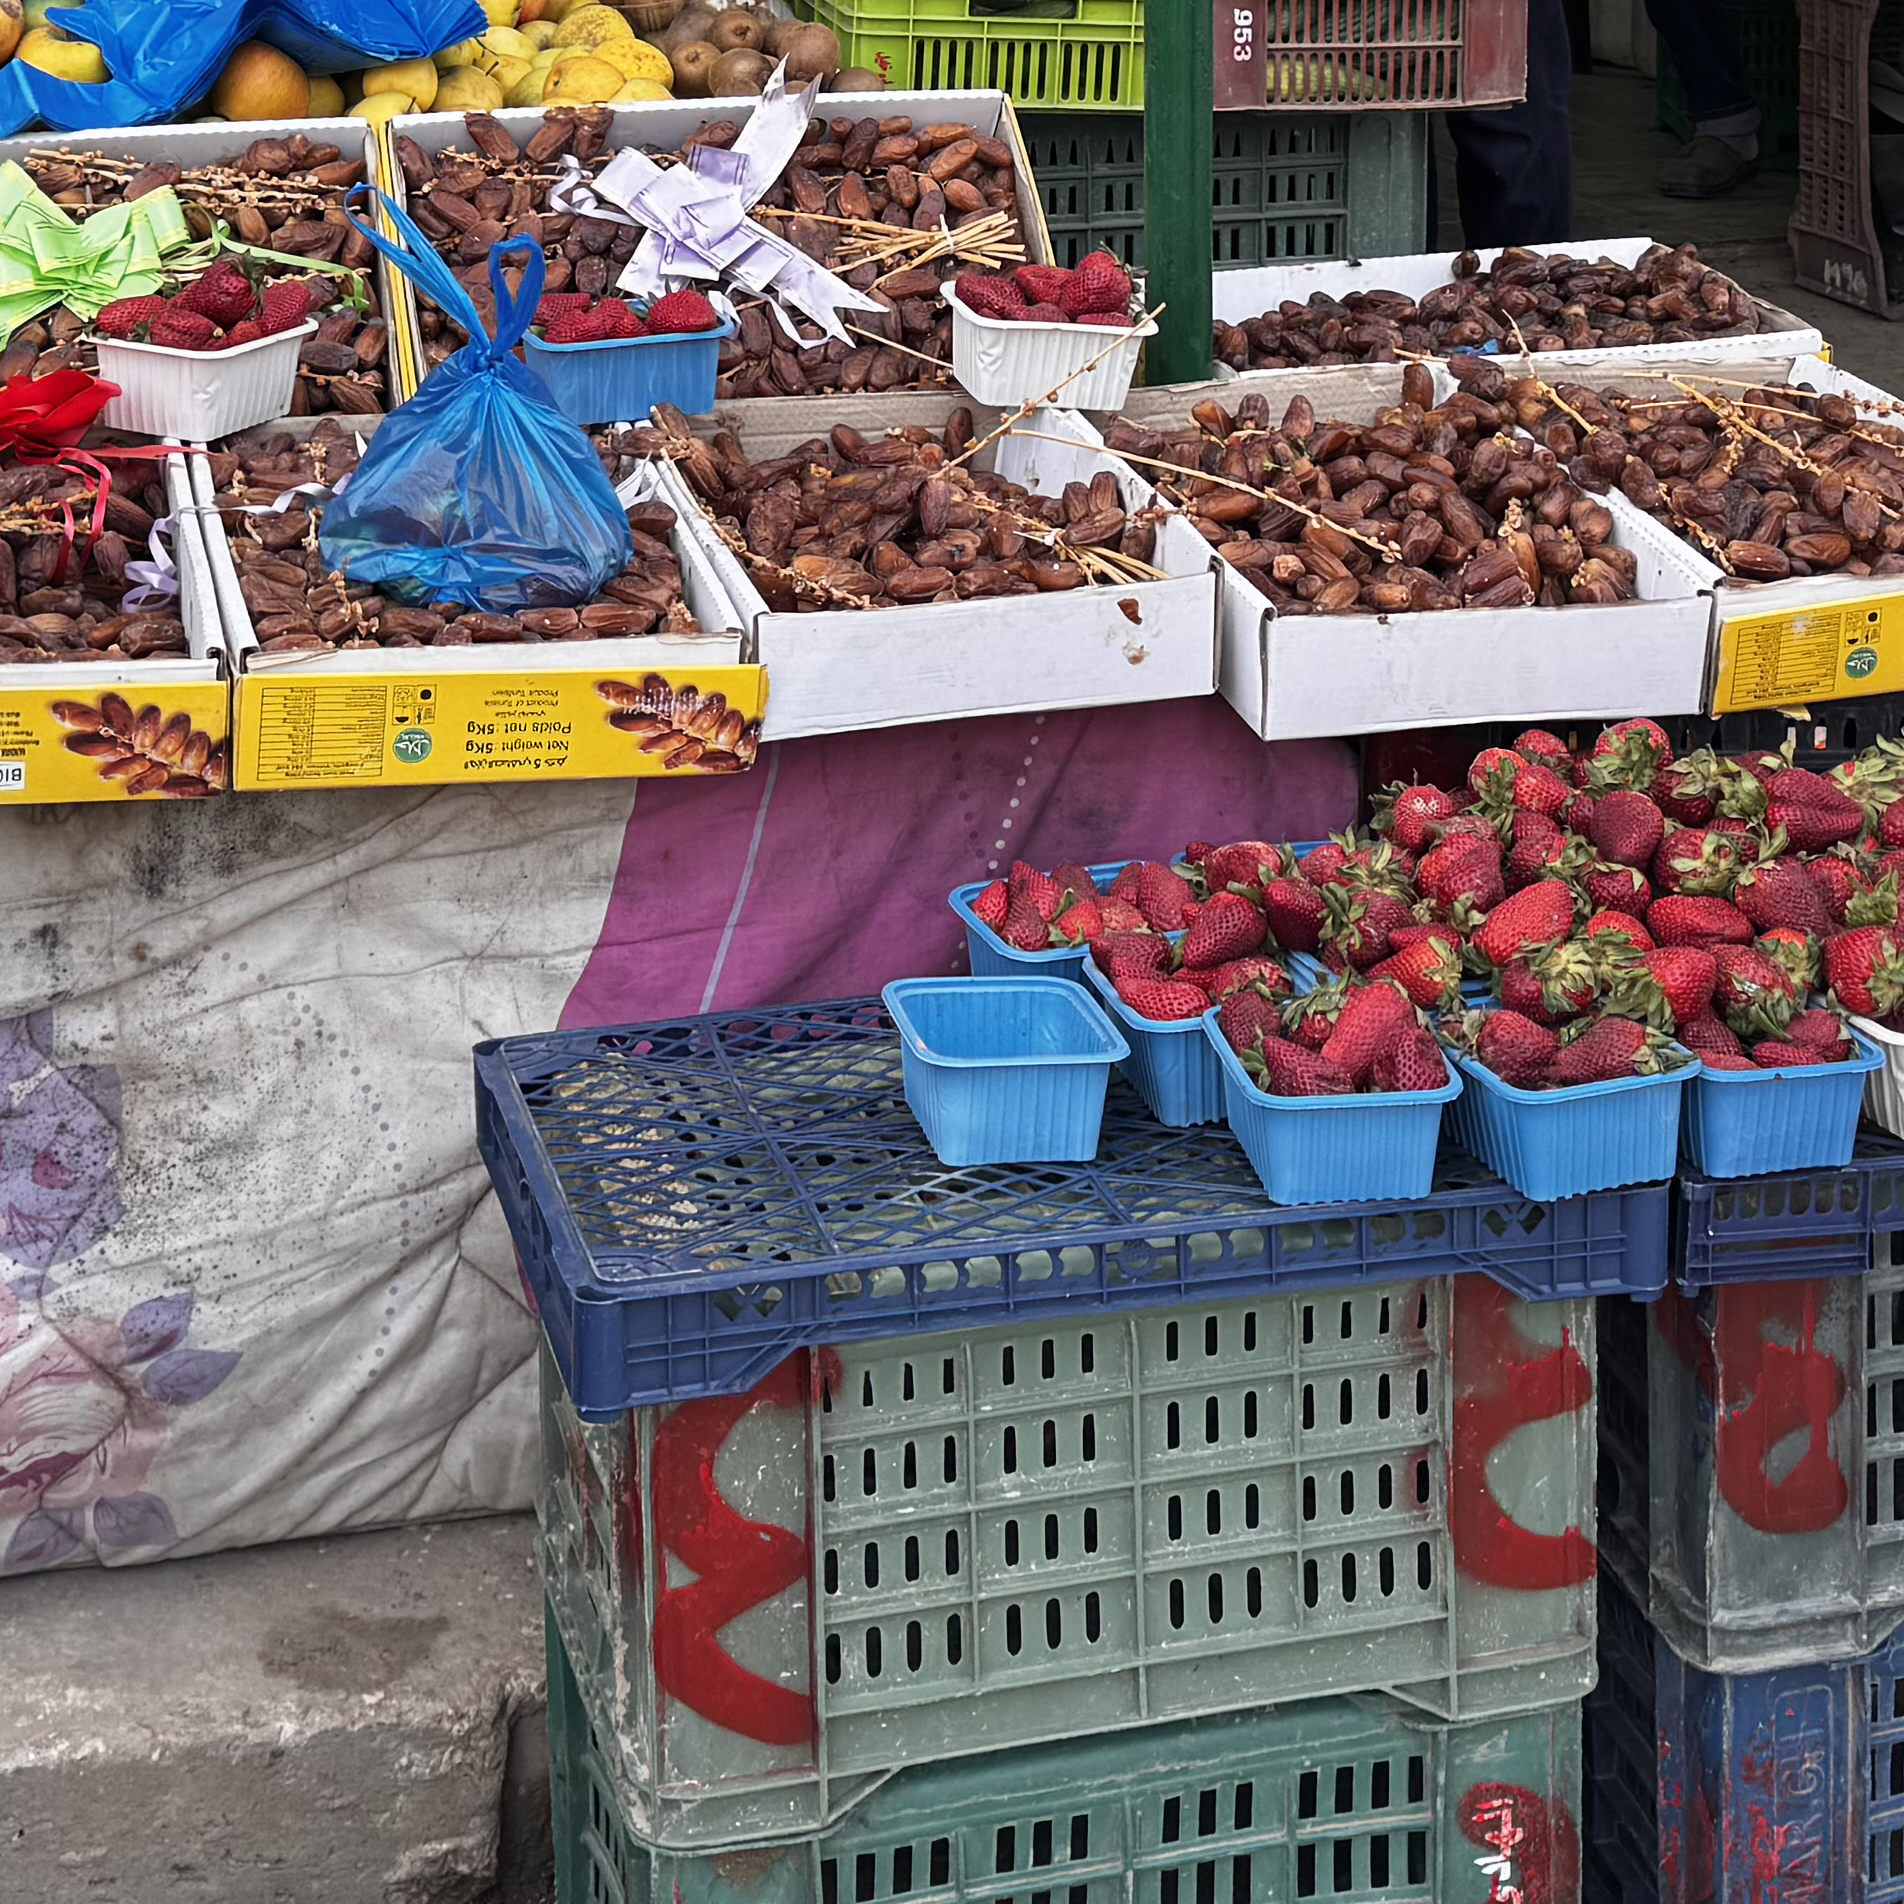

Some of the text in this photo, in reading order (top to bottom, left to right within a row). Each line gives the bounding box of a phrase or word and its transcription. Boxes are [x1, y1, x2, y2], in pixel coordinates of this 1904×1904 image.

[1234, 8, 1254, 62] 953
[1847, 656, 1876, 672] حلال
[531, 722, 572, 734] Poids
[394, 740, 430, 756] حلال
